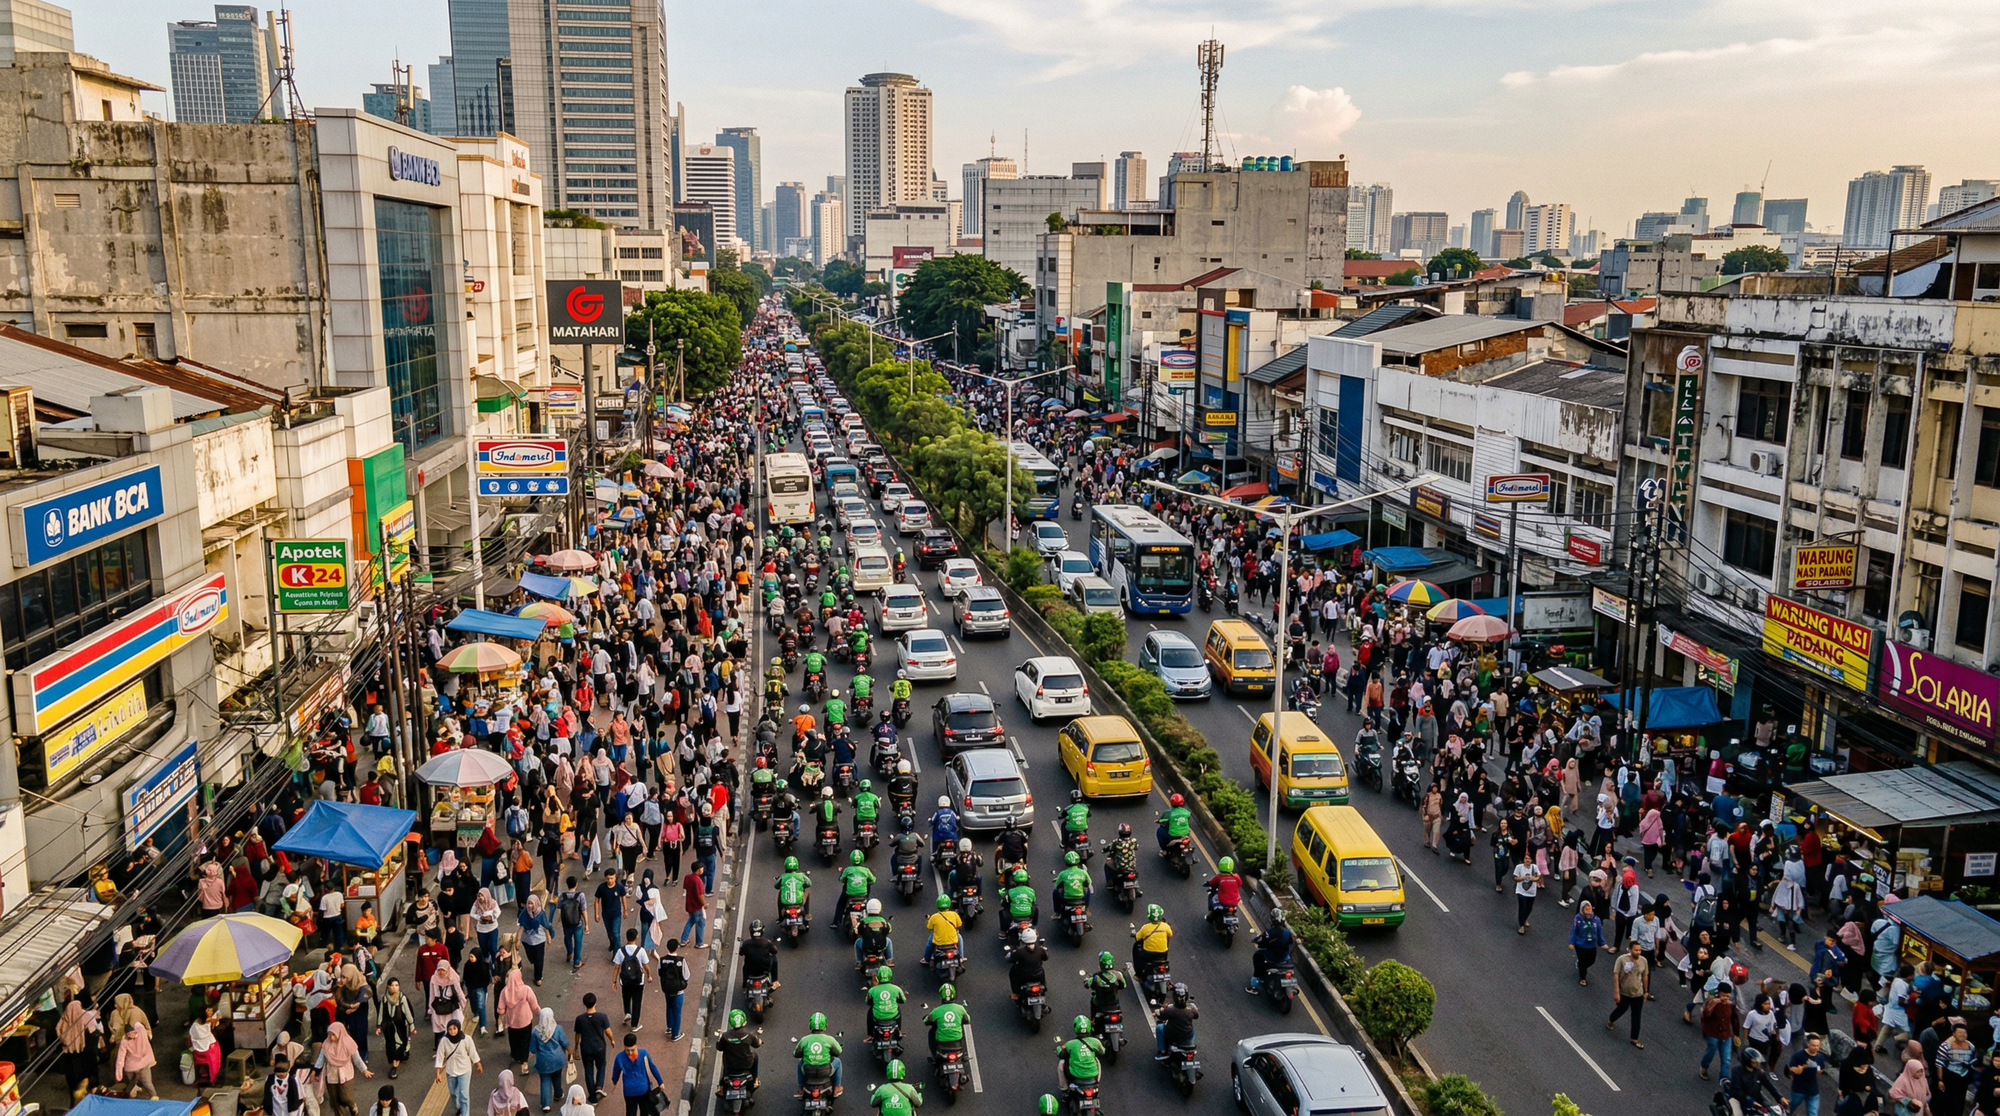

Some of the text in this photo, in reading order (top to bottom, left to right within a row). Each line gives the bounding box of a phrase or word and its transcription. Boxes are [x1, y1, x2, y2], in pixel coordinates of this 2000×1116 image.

[400, 152, 441, 186] BANK BCA
[552, 327, 619, 337] MATAHARI
[68, 481, 149, 537] BANK BCA
[280, 545, 343, 562] Apotek
[1799, 549, 1853, 565] WARUNG
[1797, 566, 1852, 578] NASI PADANG
[1771, 599, 1868, 650] WARUNG NASI
[1786, 629, 1845, 666] PADANG
[1906, 651, 1992, 728] SOLARIA
